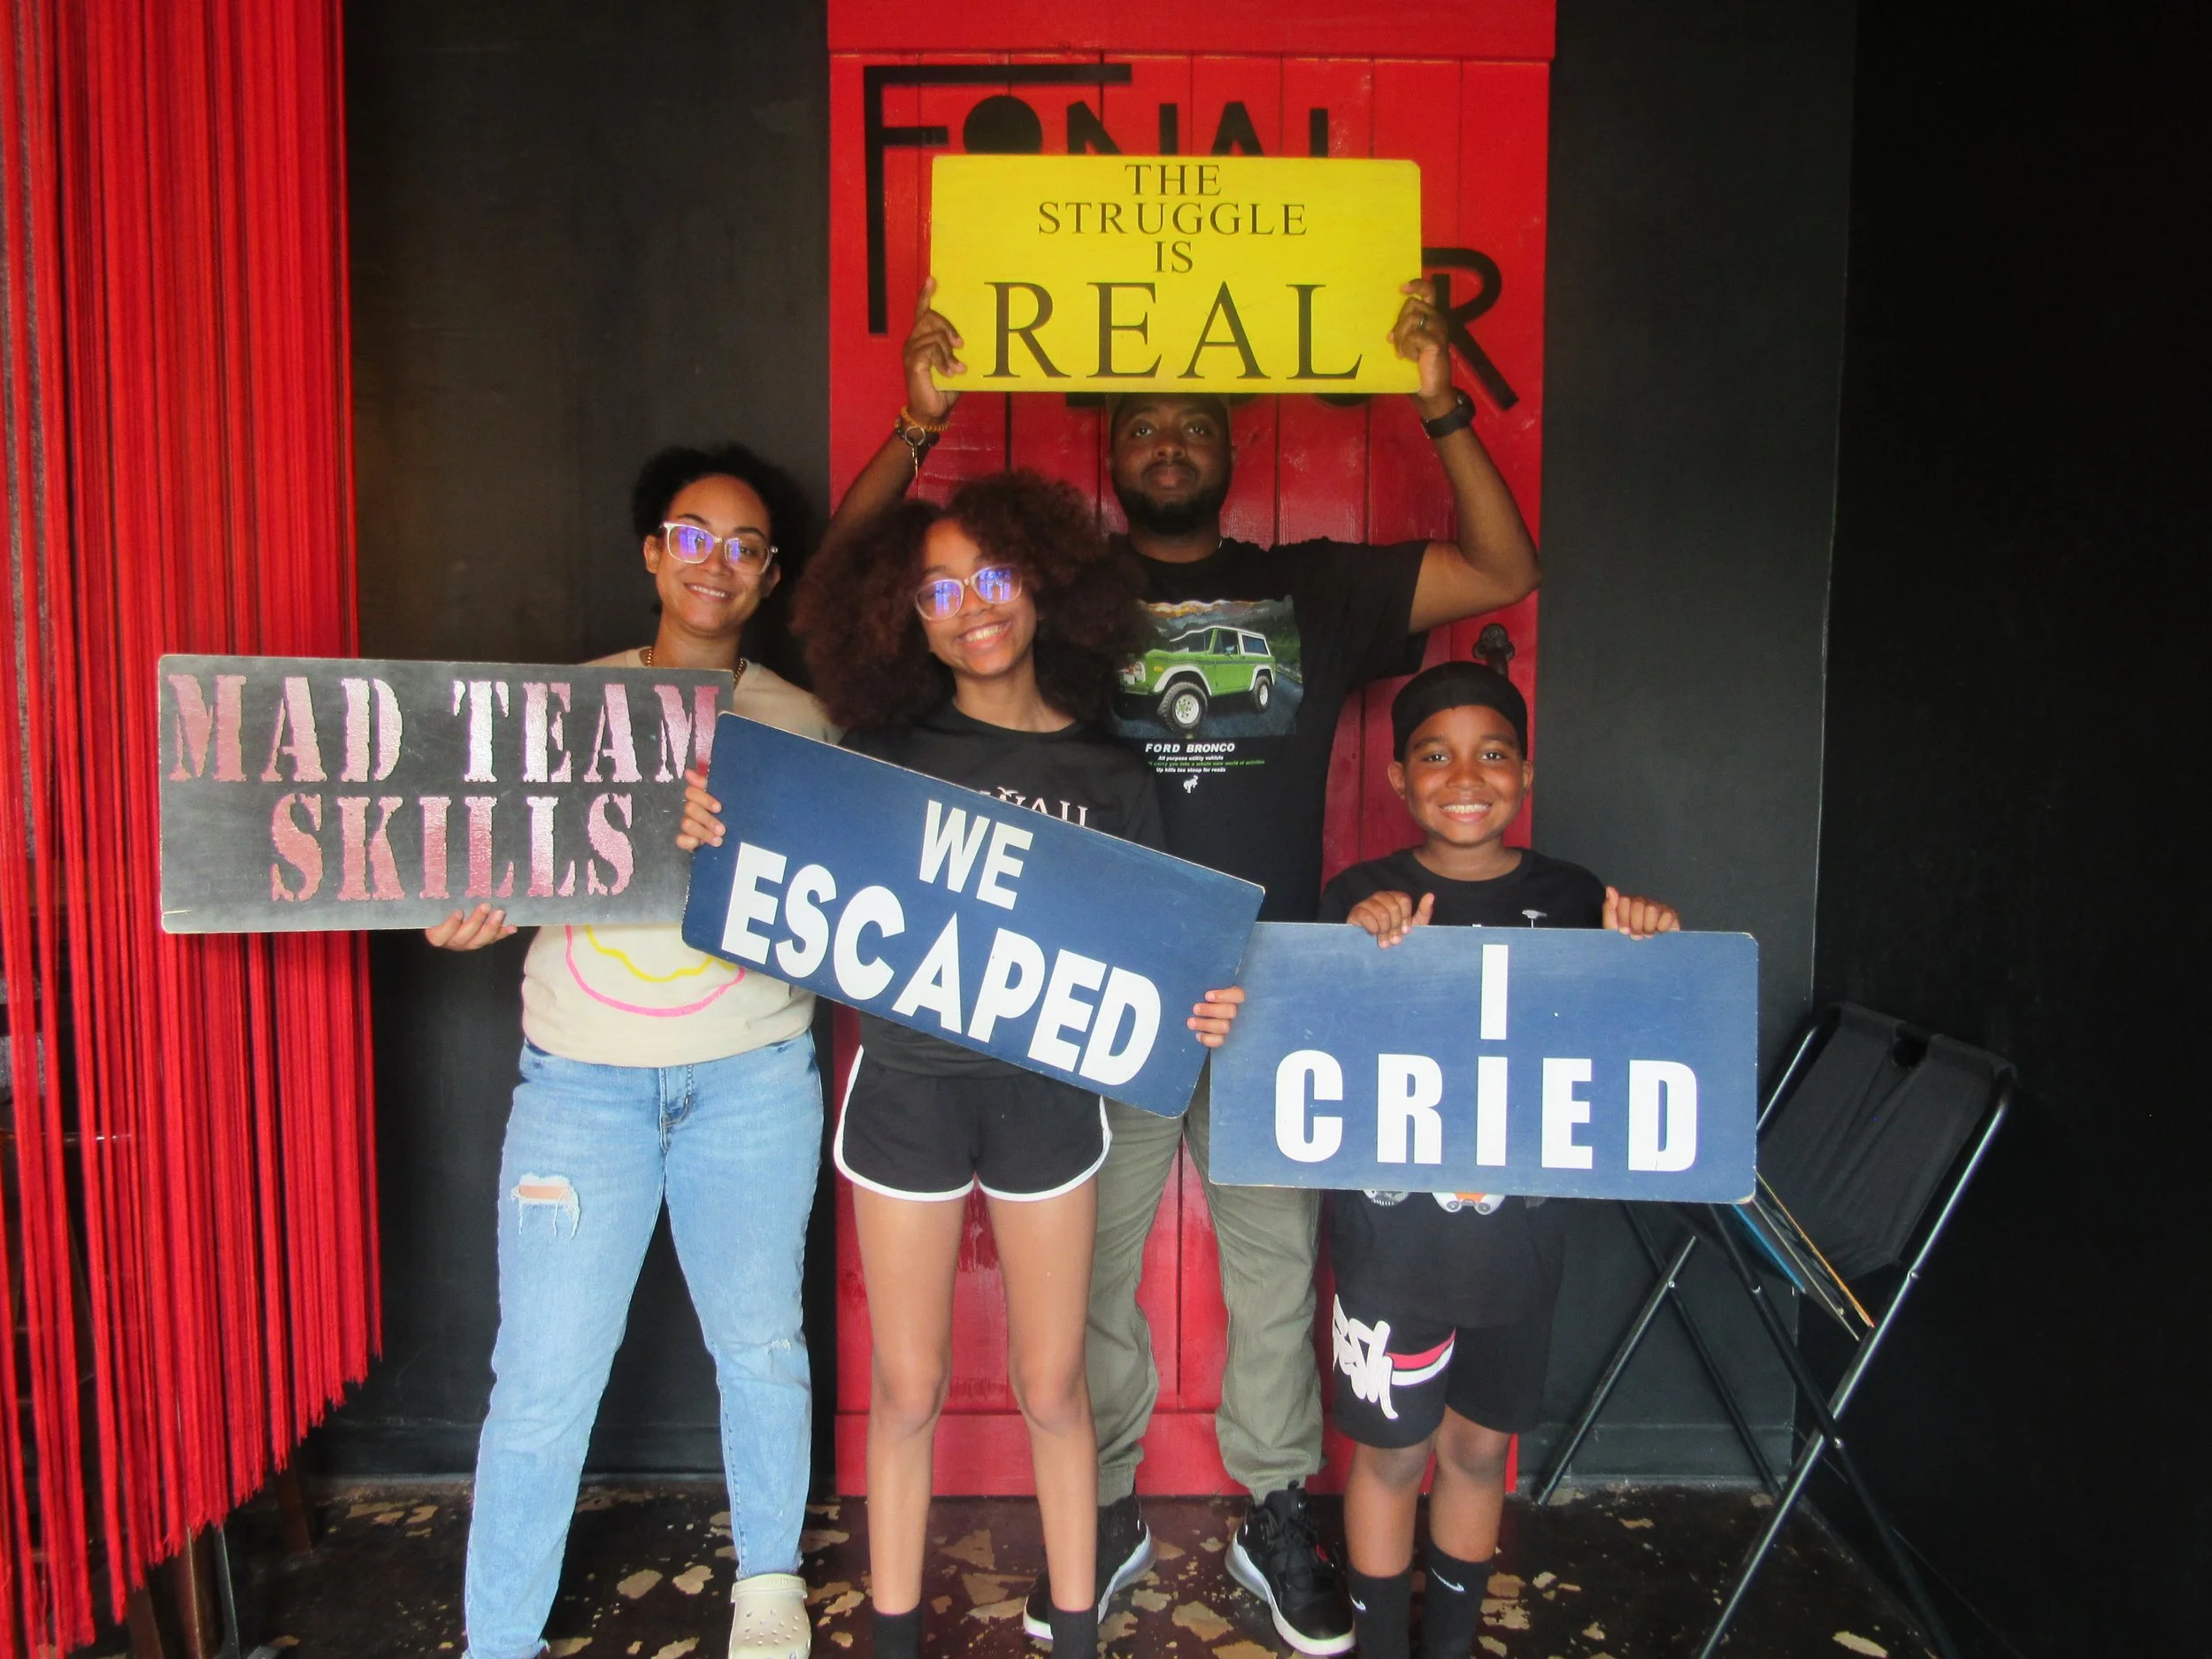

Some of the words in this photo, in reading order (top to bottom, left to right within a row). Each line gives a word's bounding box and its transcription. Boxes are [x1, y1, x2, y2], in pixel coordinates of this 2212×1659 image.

[1037, 202, 1308, 235] STRUGGLE
[1124, 164, 1223, 196] THE
[1153, 240, 1194, 273] IS
[982, 280, 1363, 380] REAL
[166, 674, 404, 783] MAD
[451, 679, 720, 783] TEAM
[1145, 743, 1180, 753] FORD
[1186, 742, 1235, 753] BRONCO
[270, 792, 634, 902] SKILLS
[918, 799, 1033, 910] WE
[720, 841, 1162, 1086] ESCAPED
[1480, 943, 1509, 1041] I
[1274, 1049, 1698, 1171] CRIED
